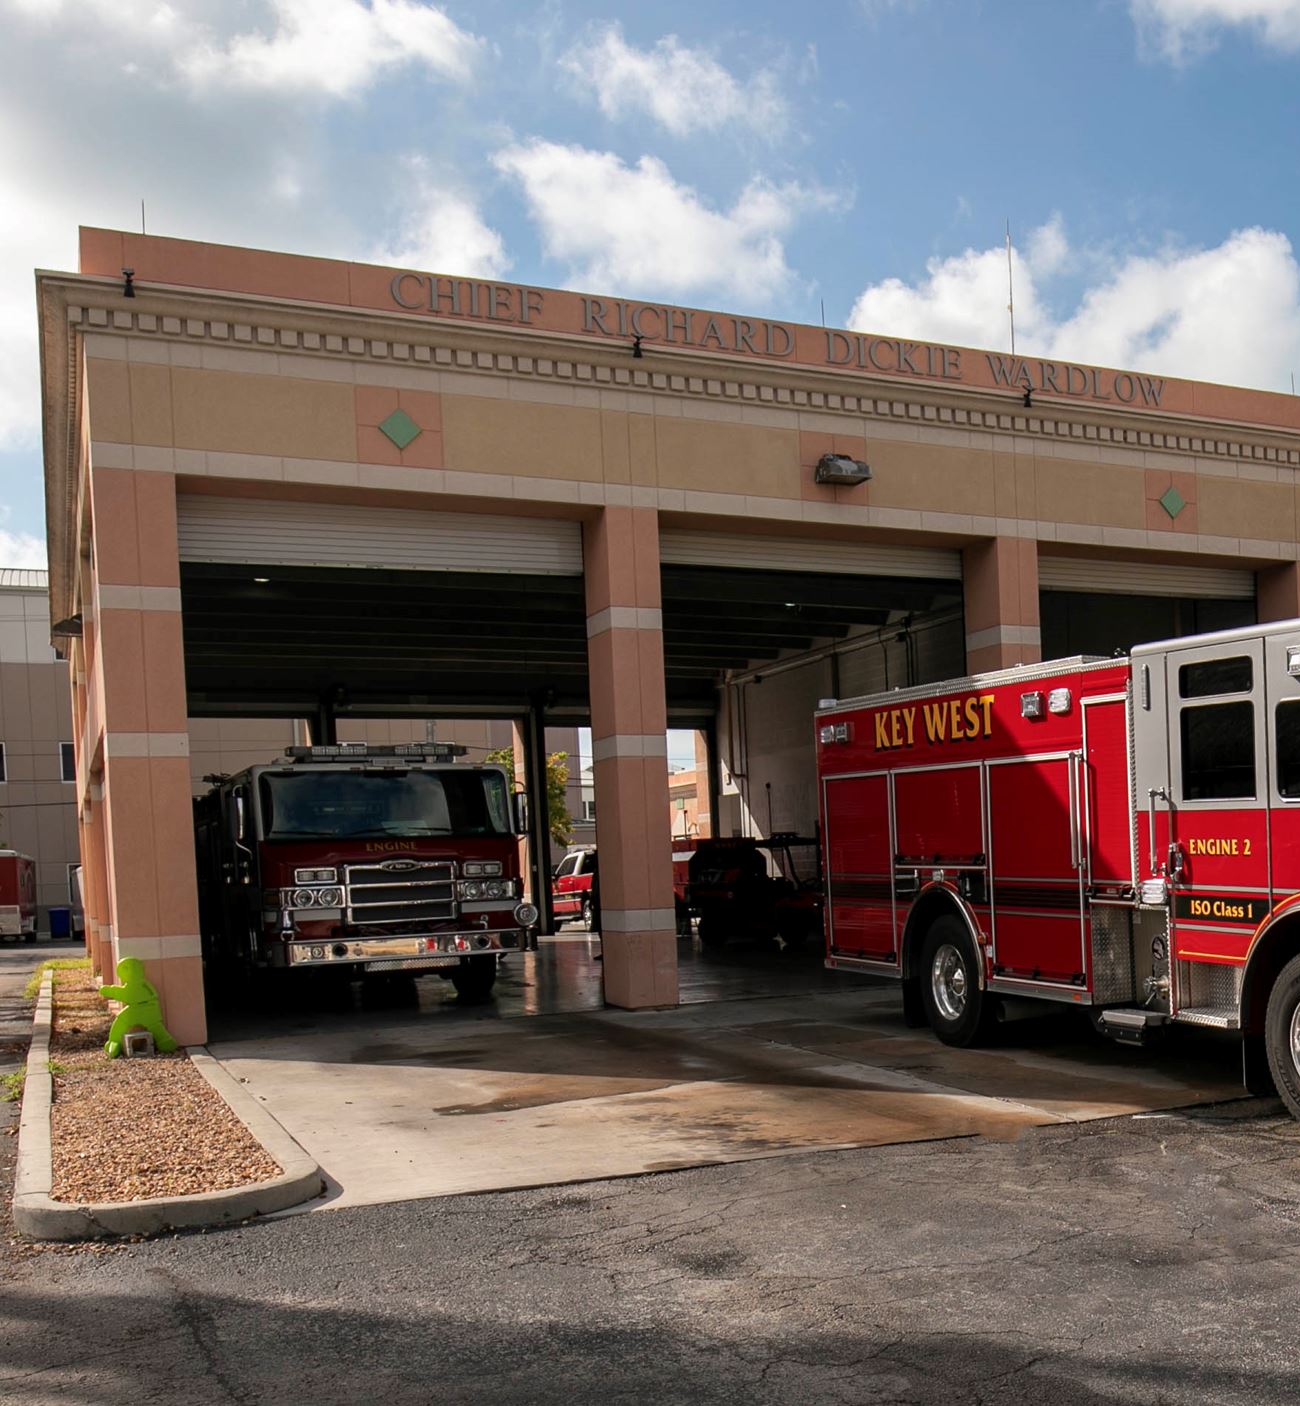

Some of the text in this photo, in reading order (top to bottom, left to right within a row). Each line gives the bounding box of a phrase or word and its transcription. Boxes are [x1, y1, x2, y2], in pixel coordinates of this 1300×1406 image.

[390, 272, 1166, 407] CHIEF RICHARD DICKIE WARDLOW
[874, 694, 995, 749] KEY WEST
[366, 840, 417, 852] ENGINE
[1189, 839, 1251, 855] ENGINE 2
[1191, 900, 1253, 918] ISO Class 1
